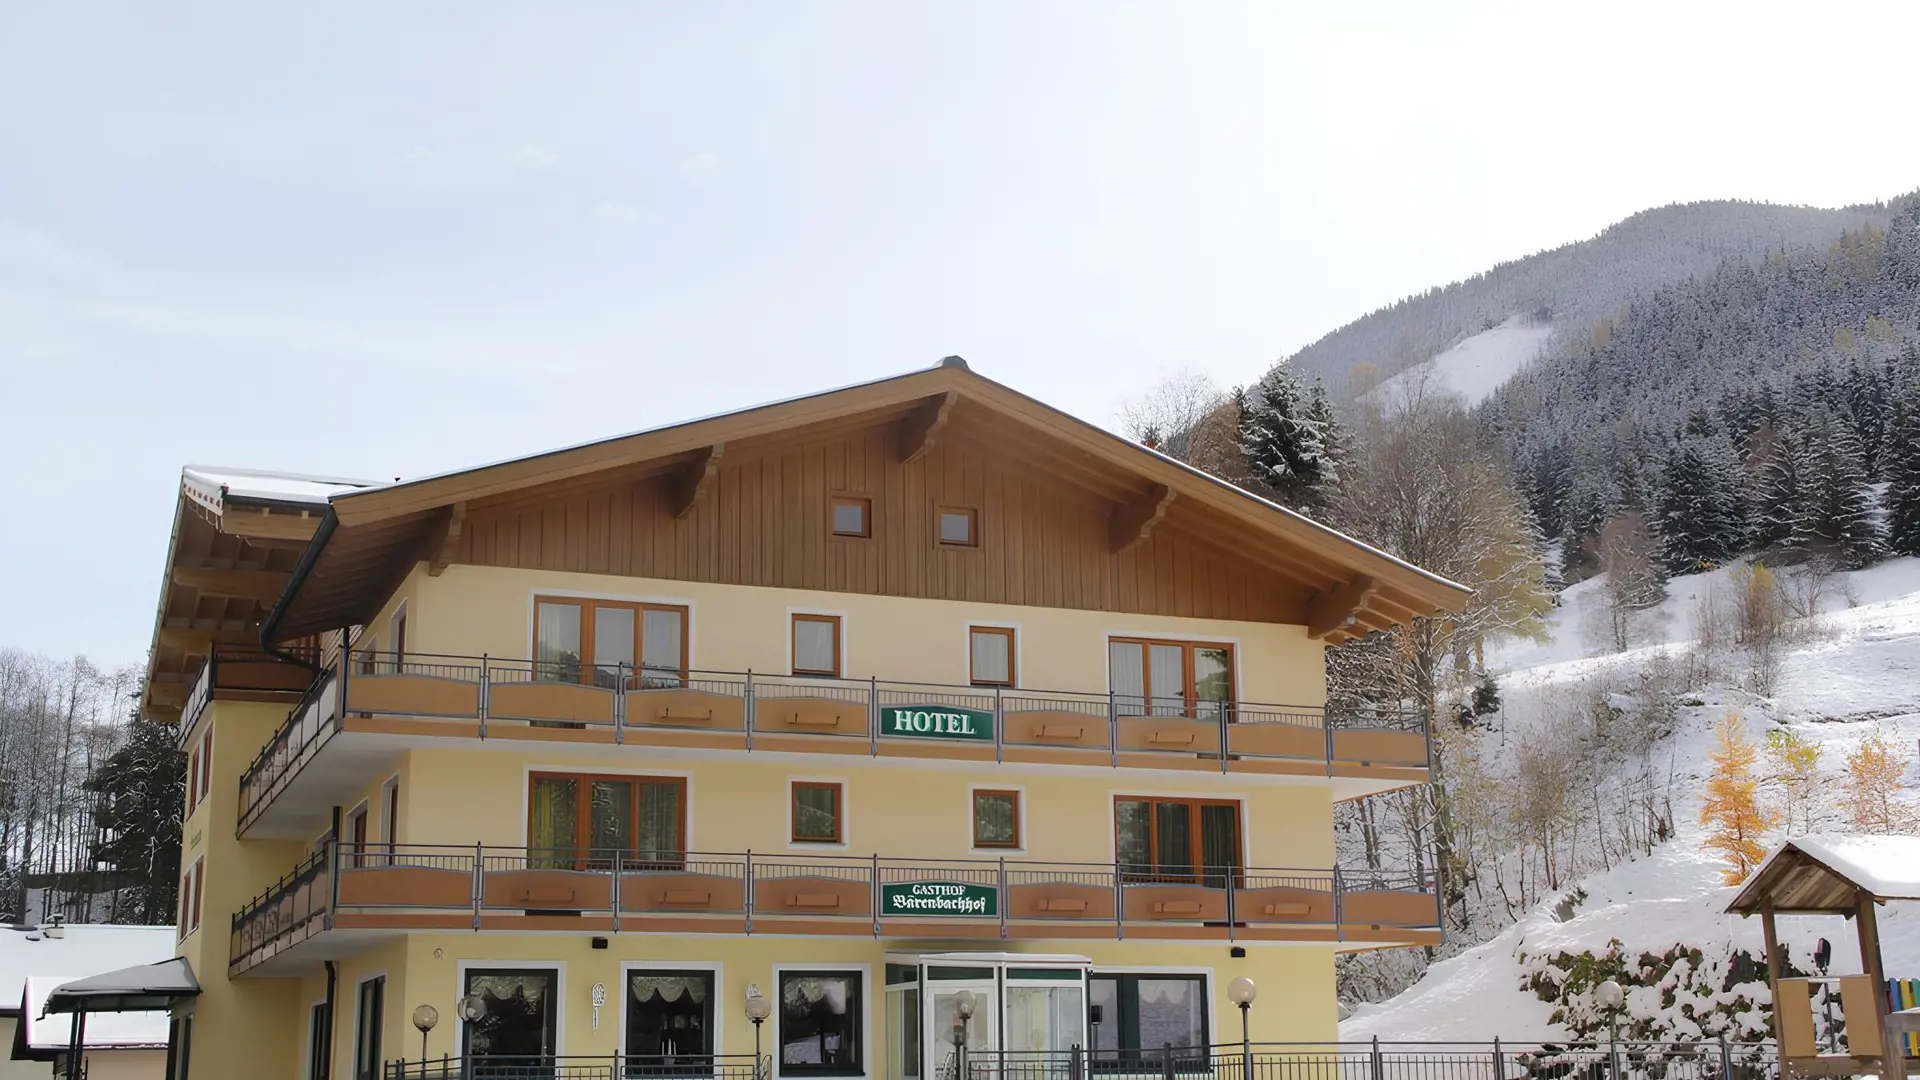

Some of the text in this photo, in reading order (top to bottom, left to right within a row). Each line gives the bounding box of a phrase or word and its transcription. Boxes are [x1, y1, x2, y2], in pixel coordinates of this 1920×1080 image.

[894, 710, 976, 734] HOTEL
[912, 884, 966, 896] GASTHOF
[892, 895, 986, 913] Bärenbachhof
